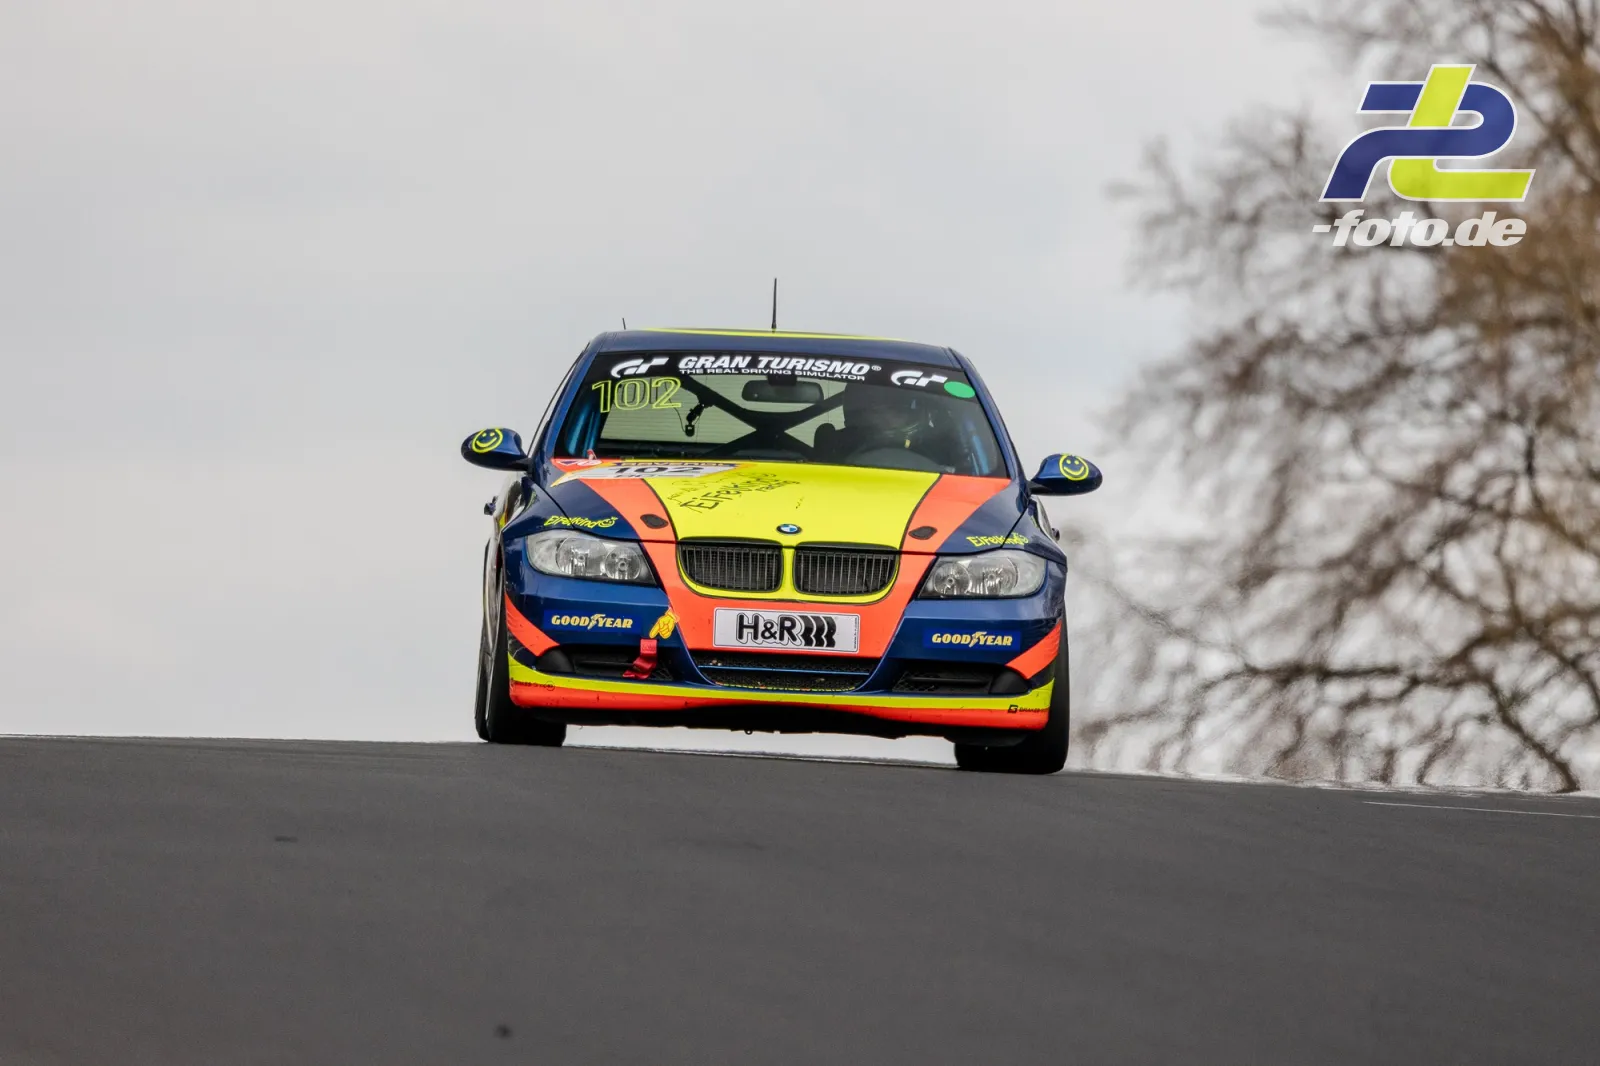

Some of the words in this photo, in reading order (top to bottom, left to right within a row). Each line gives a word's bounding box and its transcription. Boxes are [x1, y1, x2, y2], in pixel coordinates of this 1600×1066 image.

[678, 355, 751, 369] GRAN
[741, 368, 792, 376] DRIVING
[795, 370, 865, 381] SIMULATOR
[592, 377, 681, 413] 102
[737, 613, 802, 645] H&R
